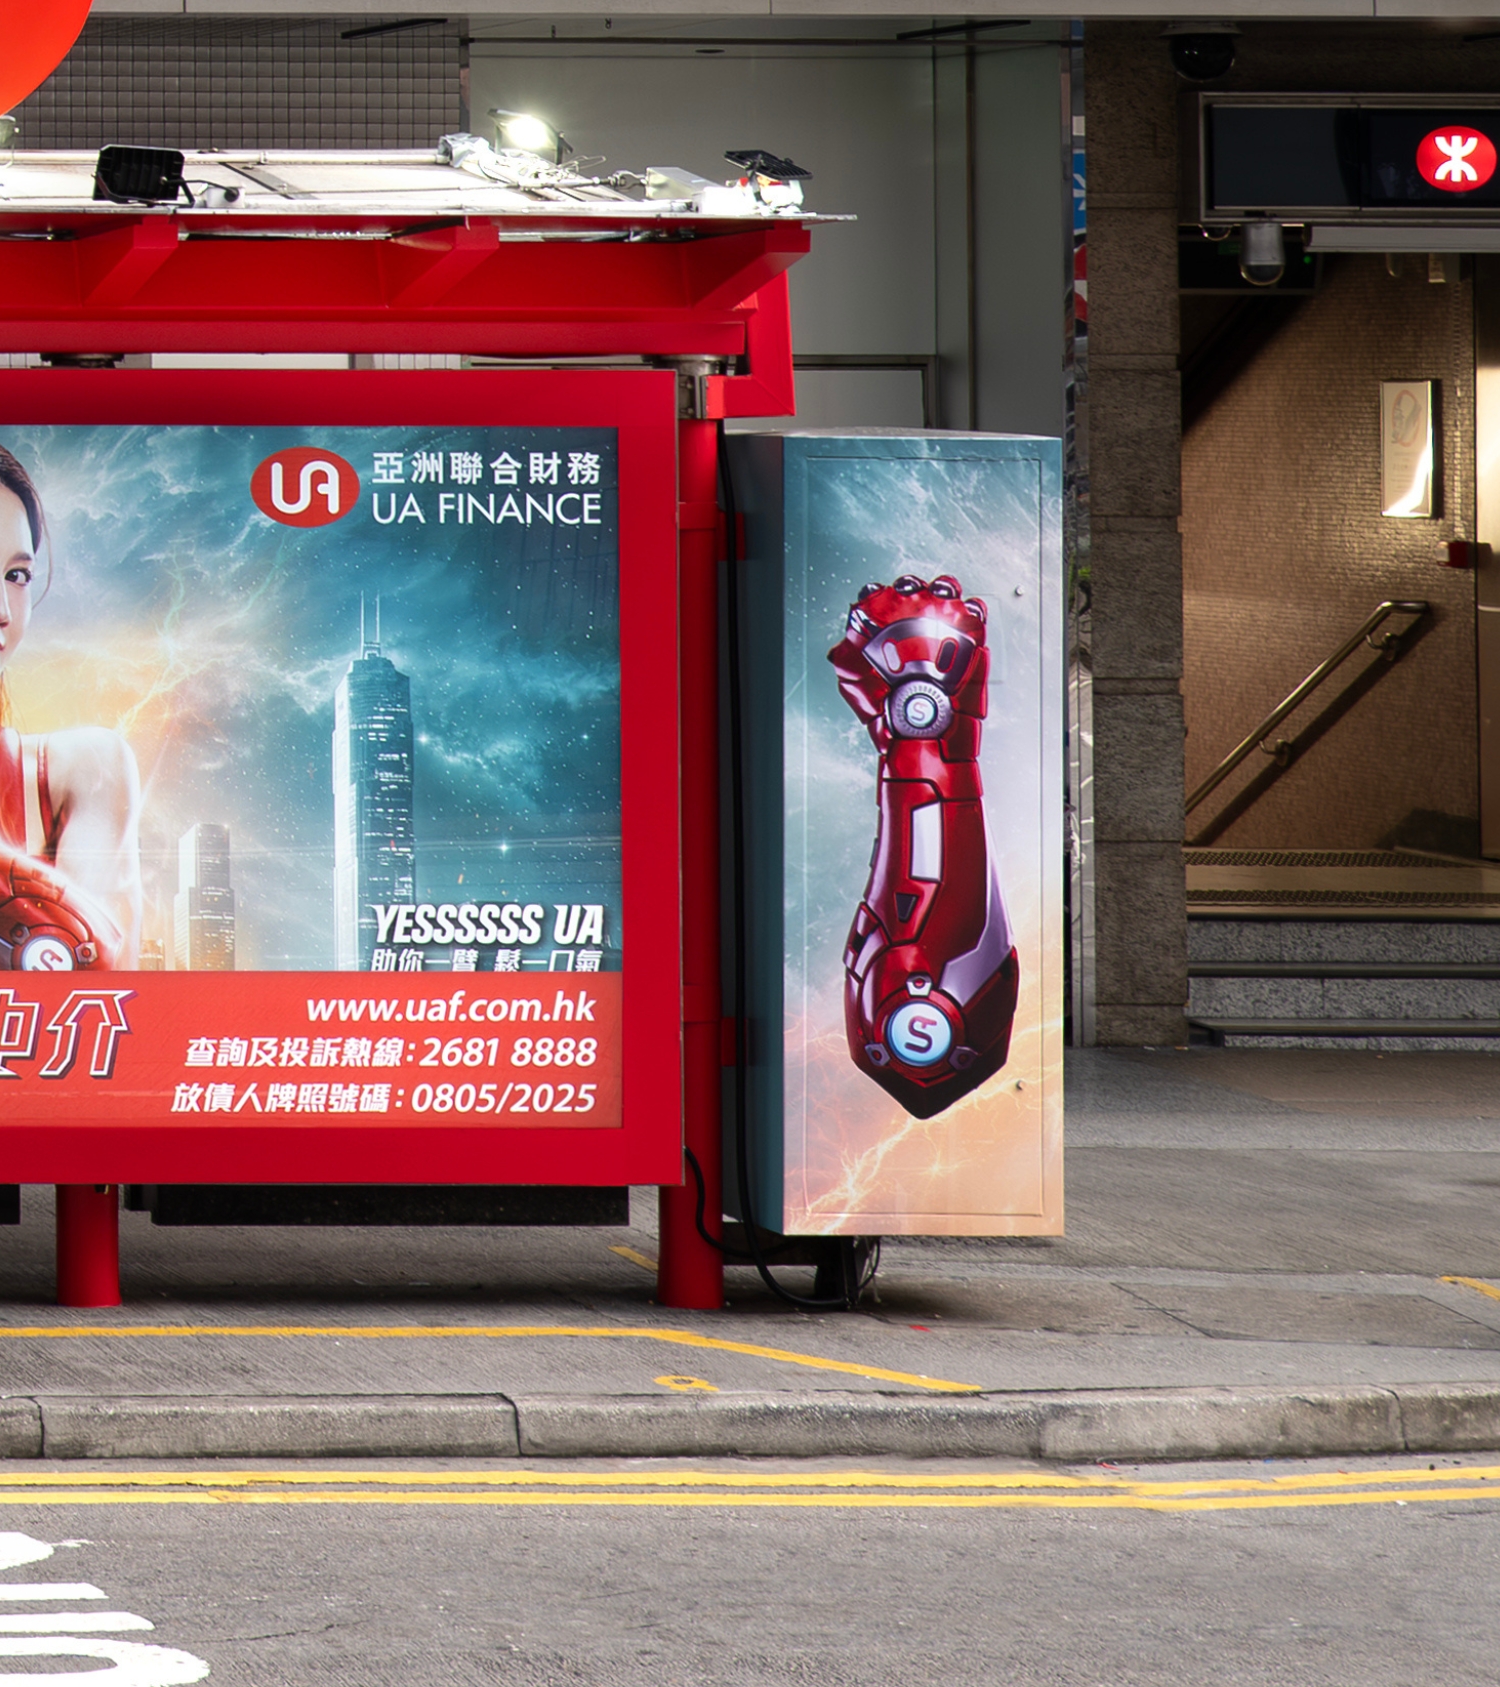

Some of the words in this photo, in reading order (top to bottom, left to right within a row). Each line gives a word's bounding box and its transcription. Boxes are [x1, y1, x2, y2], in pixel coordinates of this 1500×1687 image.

[373, 453, 600, 485] 亞洲聯合財務
[373, 494, 426, 524] UA
[438, 494, 602, 524] FINANCE
[554, 904, 603, 945] UA
[306, 993, 595, 1025] www.uaf.com.hk
[512, 1039, 596, 1069] 8888
